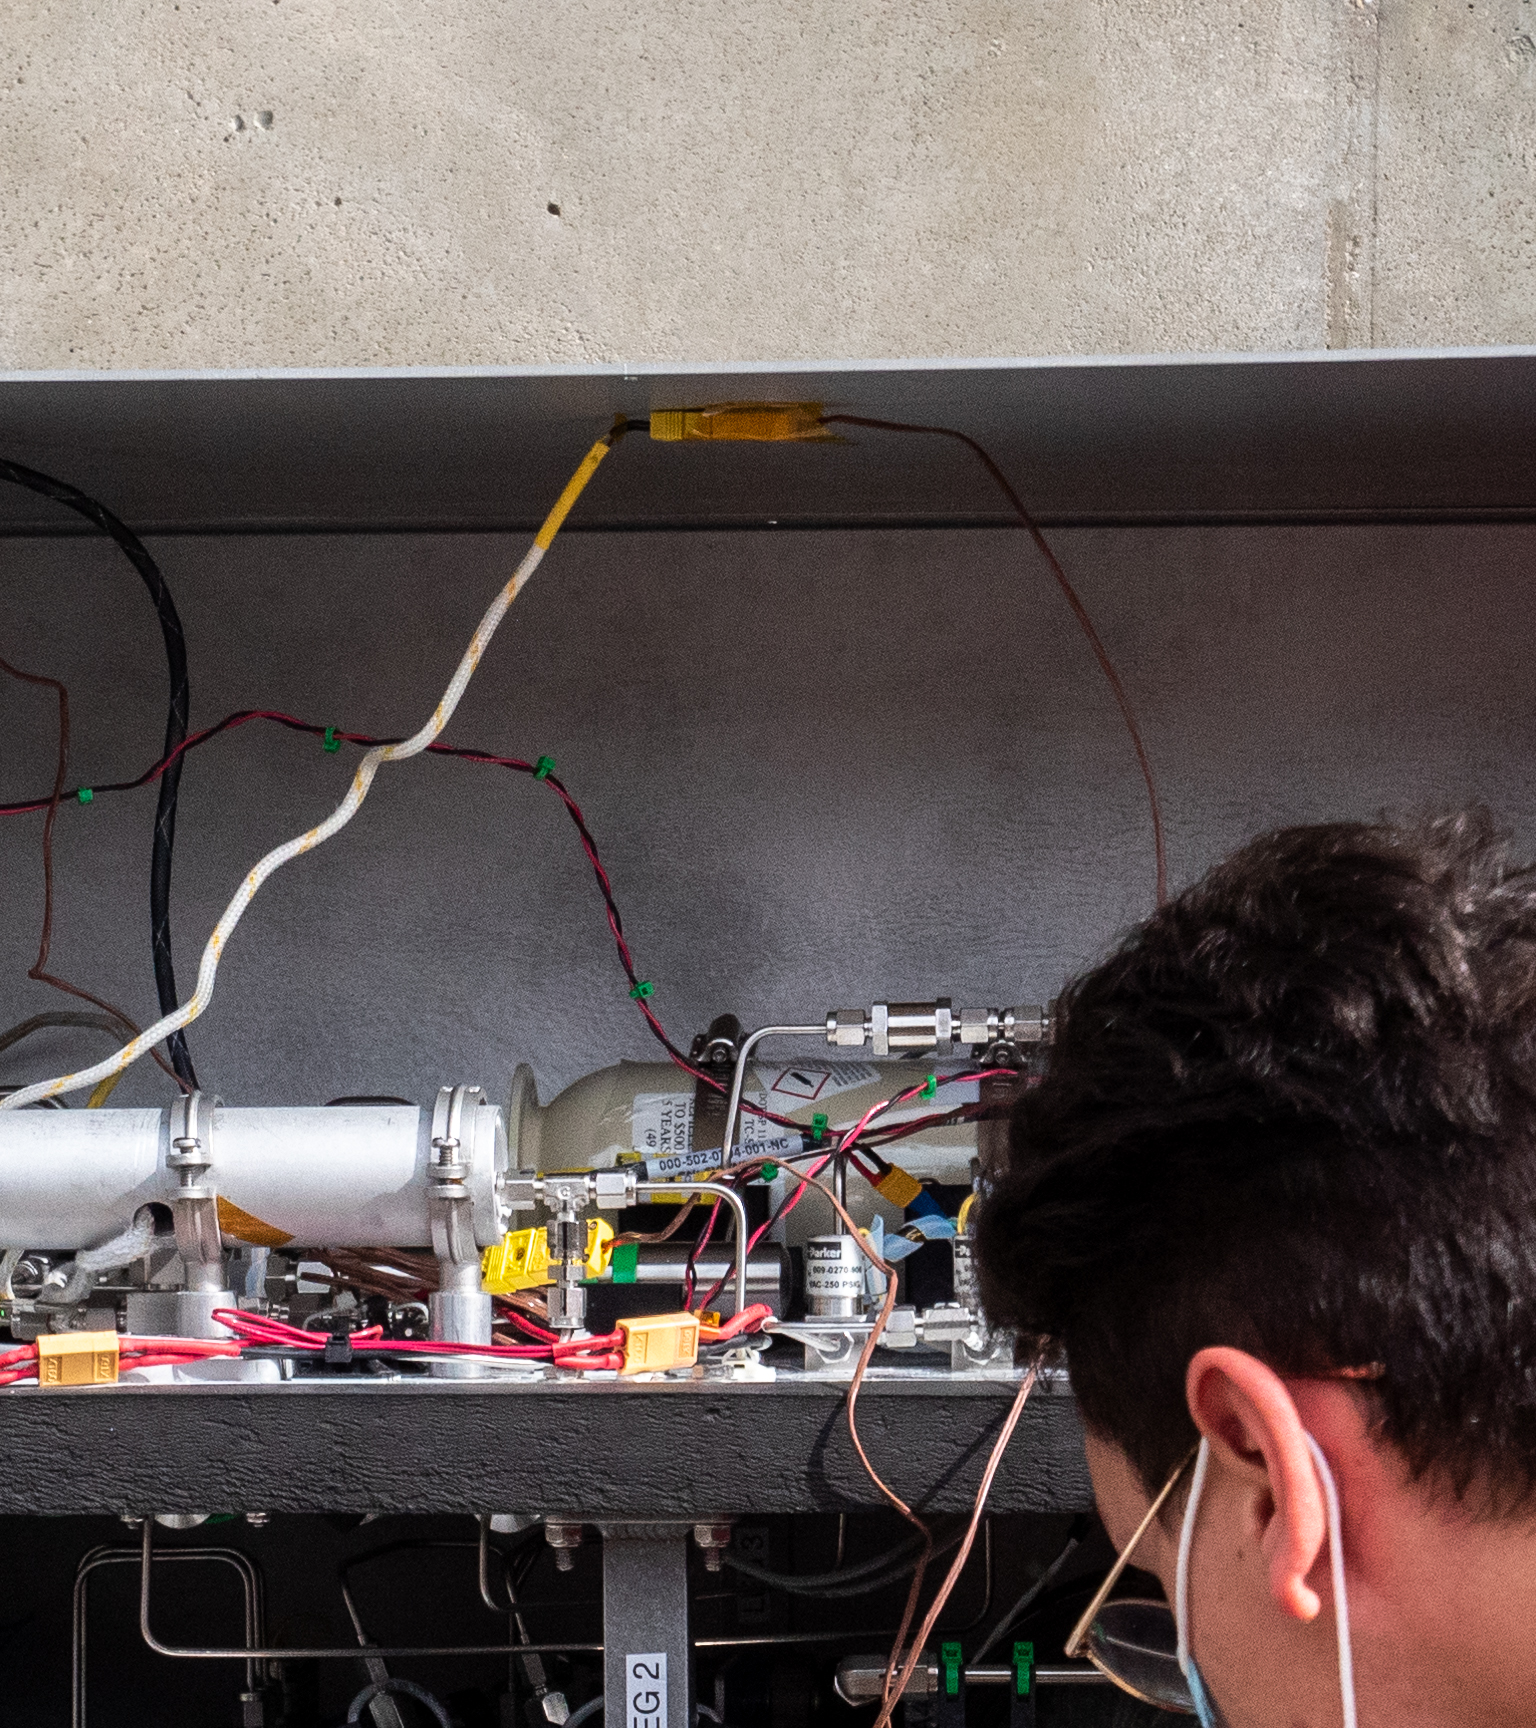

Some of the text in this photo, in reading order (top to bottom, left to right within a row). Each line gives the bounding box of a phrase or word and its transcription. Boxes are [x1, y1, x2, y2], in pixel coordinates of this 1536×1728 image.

[660, 1110, 672, 1154] YEARS
[673, 1102, 686, 1150] TO $500
[632, 1662, 660, 1680] 2
